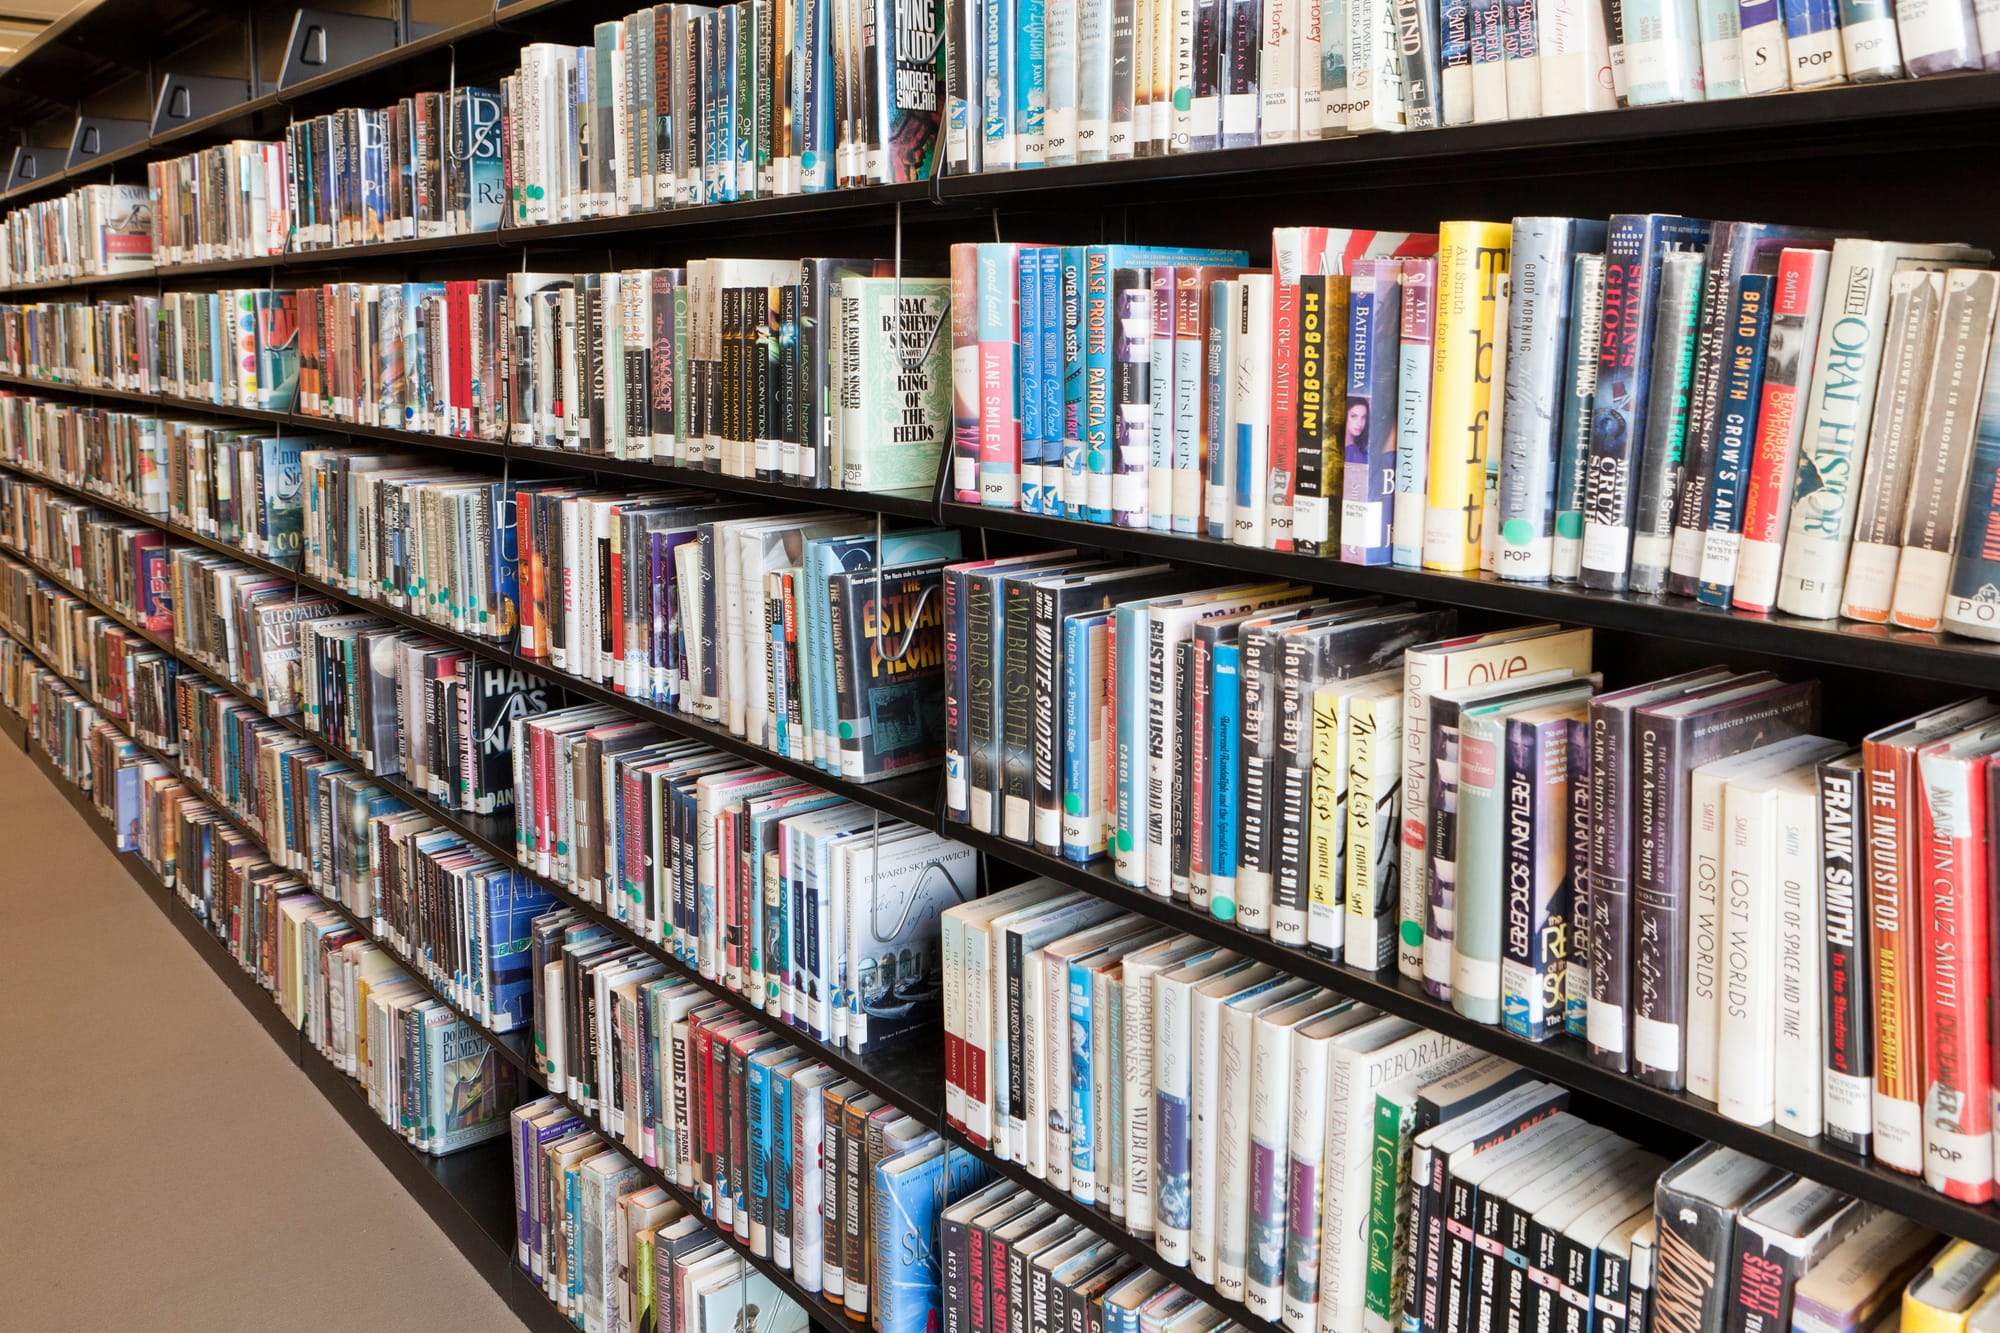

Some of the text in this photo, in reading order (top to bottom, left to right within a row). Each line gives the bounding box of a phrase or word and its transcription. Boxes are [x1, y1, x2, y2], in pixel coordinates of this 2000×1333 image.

[896, 70, 936, 91] ANDREW
[1797, 51, 1833, 68] POP
[897, 90, 936, 111] SINCLAIR
[1327, 104, 1347, 113] POP
[1347, 101, 1369, 112] POP
[1079, 130, 1094, 139] POP
[1064, 265, 1076, 300] COVER
[1783, 271, 1798, 309] SMITH
[1847, 266, 1869, 314] SMITH
[1064, 302, 1077, 326] YOUR
[1520, 263, 1536, 353] GOOD MORNING,
[1602, 264, 1622, 368] GHOST
[1621, 264, 1639, 367] STALIN'S
[1089, 254, 1106, 427] FALSE PROFITS PATRICIA
[1277, 317, 1291, 357] CRUZ
[1353, 306, 1369, 389] BATHSHEBA
[593, 339, 604, 399] MANOR
[898, 377, 928, 391] KING
[1276, 361, 1290, 409] SMITH
[1818, 318, 1870, 410] ORAL
[850, 382, 859, 409] SINGER
[902, 409, 925, 425] THE
[906, 392, 920, 407] OF
[984, 352, 1001, 452] JANE SMILEY
[1711, 291, 1760, 533] BRAD SMITH CROW'S LAND
[893, 425, 934, 442] FIELDS
[1762, 411, 1777, 460] THINGS
[1769, 392, 1794, 489] REMEMBRANCE
[986, 485, 1002, 493] POP
[1586, 455, 1602, 523] SMITH
[1598, 456, 1616, 525] CRUZ
[1235, 520, 1253, 530] POP
[1271, 518, 1293, 529] POP
[1658, 494, 1672, 539] Smith
[1505, 551, 1531, 561] POP
[784, 587, 793, 632] ROSEANNA
[1041, 592, 1053, 619] APRIL
[970, 593, 992, 740] WILBUR SMITH
[1006, 599, 1030, 747] WILBUR SMITH
[1036, 624, 1053, 693] WHITE
[1149, 620, 1165, 760] BUSTED FLUSH
[1035, 692, 1052, 791] SHOTGUN
[1119, 745, 1127, 779] CAROL
[1405, 662, 1427, 818] Love Her Madly
[1285, 767, 1302, 823] MARTIN
[1643, 730, 1656, 881] CLARK ASHTON SMITH
[1282, 829, 1299, 862] CRUZ
[1825, 776, 1853, 948] FRANK SMITH
[1871, 769, 1899, 933] THE INQUISITOR
[1509, 782, 1530, 959] RETURN SORCERER
[1786, 880, 1800, 908] OUT
[1276, 921, 1299, 932] POP
[1696, 854, 1717, 1000] LOST WORLDS
[1728, 870, 1749, 1020] LOST WORLDS
[1930, 879, 1956, 1007] CRUZ SMITH
[1784, 932, 1800, 973] SPACE
[1138, 976, 1154, 1098] LEOPARD HUNTS
[1782, 1007, 1799, 1041] TIME
[673, 1039, 688, 1126] CODE FIVE
[1129, 1106, 1147, 1160] WILBUR
[1930, 1144, 1962, 1163] POP
[846, 1139, 859, 1236] KARIN SLAUGHTER
[1433, 1158, 1442, 1193] SMITH
[970, 1230, 979, 1271] FRANK
[1425, 1216, 1440, 1278] SKYLARK
[1032, 1271, 1046, 1319] FRANK
[1740, 1253, 1763, 1304] SMITH
[1760, 1260, 1783, 1318] SCOTT
